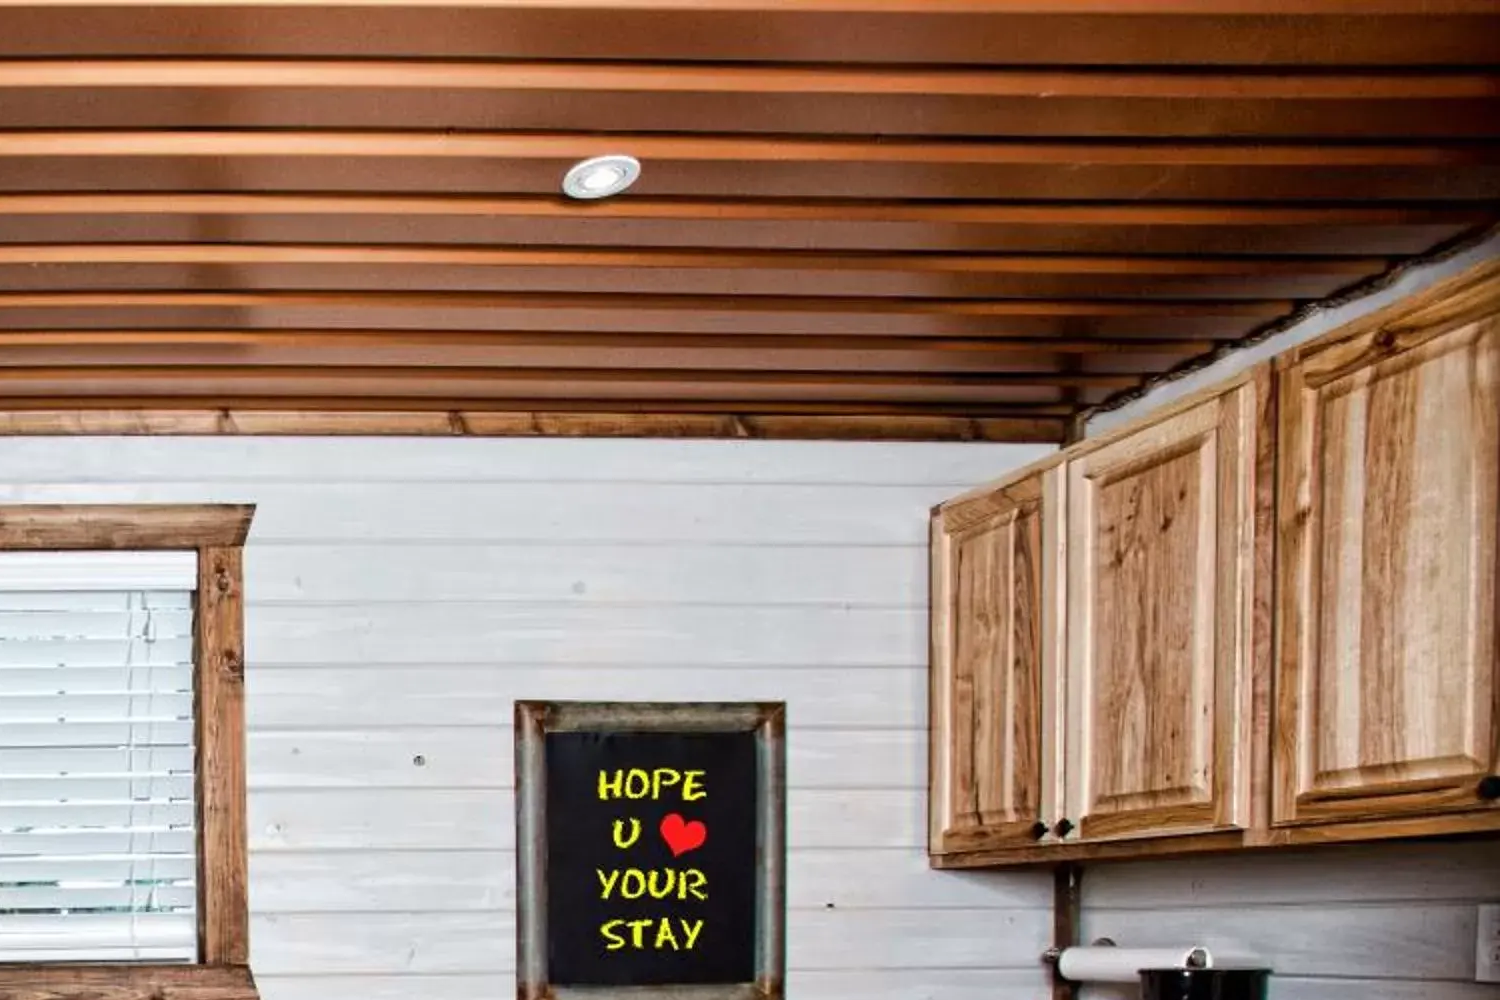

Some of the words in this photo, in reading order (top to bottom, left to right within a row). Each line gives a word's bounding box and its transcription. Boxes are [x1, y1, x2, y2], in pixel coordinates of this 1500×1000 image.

[597, 768, 708, 801] HOPE
[612, 817, 642, 849] U
[595, 867, 709, 901] YOUR
[600, 917, 704, 951] STAY
